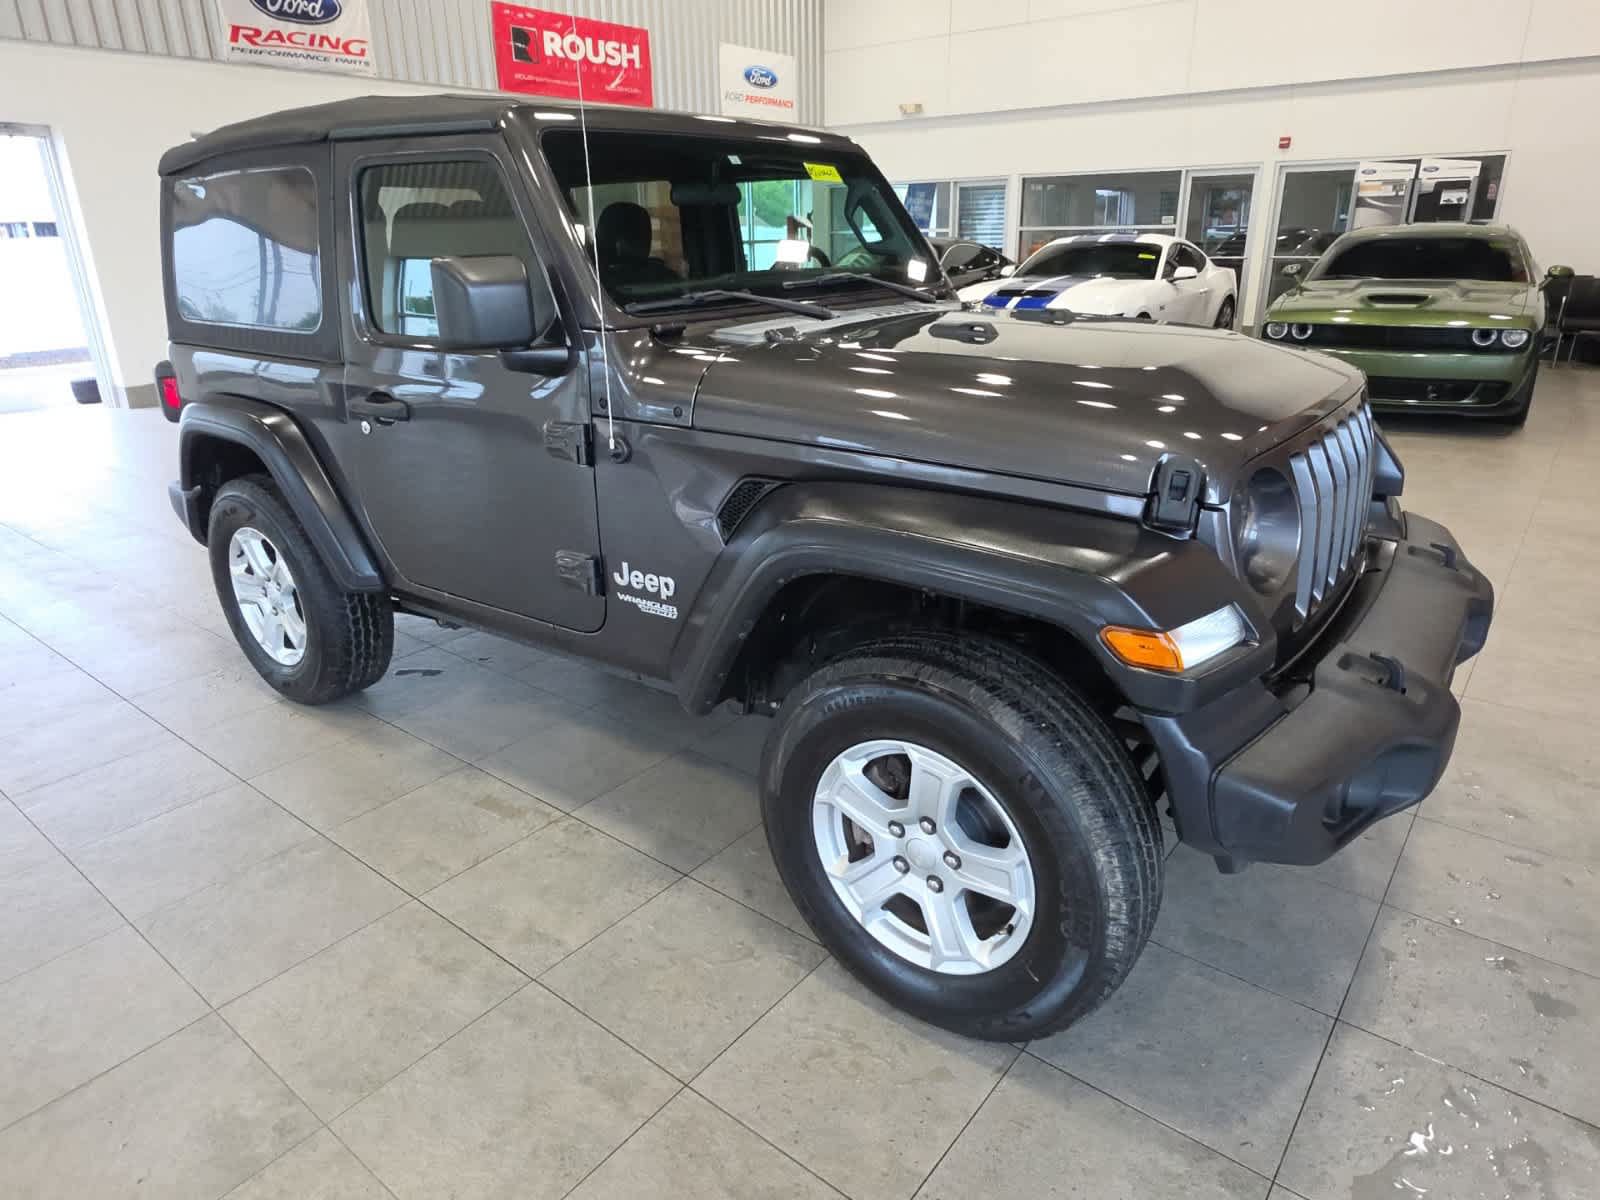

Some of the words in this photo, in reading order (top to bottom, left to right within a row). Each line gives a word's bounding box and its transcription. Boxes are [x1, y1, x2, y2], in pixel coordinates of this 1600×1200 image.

[229, 24, 369, 57] RACING
[543, 30, 641, 69] ROUSH
[231, 46, 331, 63] PERFORMANCE
[334, 57, 371, 67] PARTS
[750, 68, 772, 86] Ford
[613, 561, 675, 600] Jeep
[616, 591, 677, 613] WRANGLER
